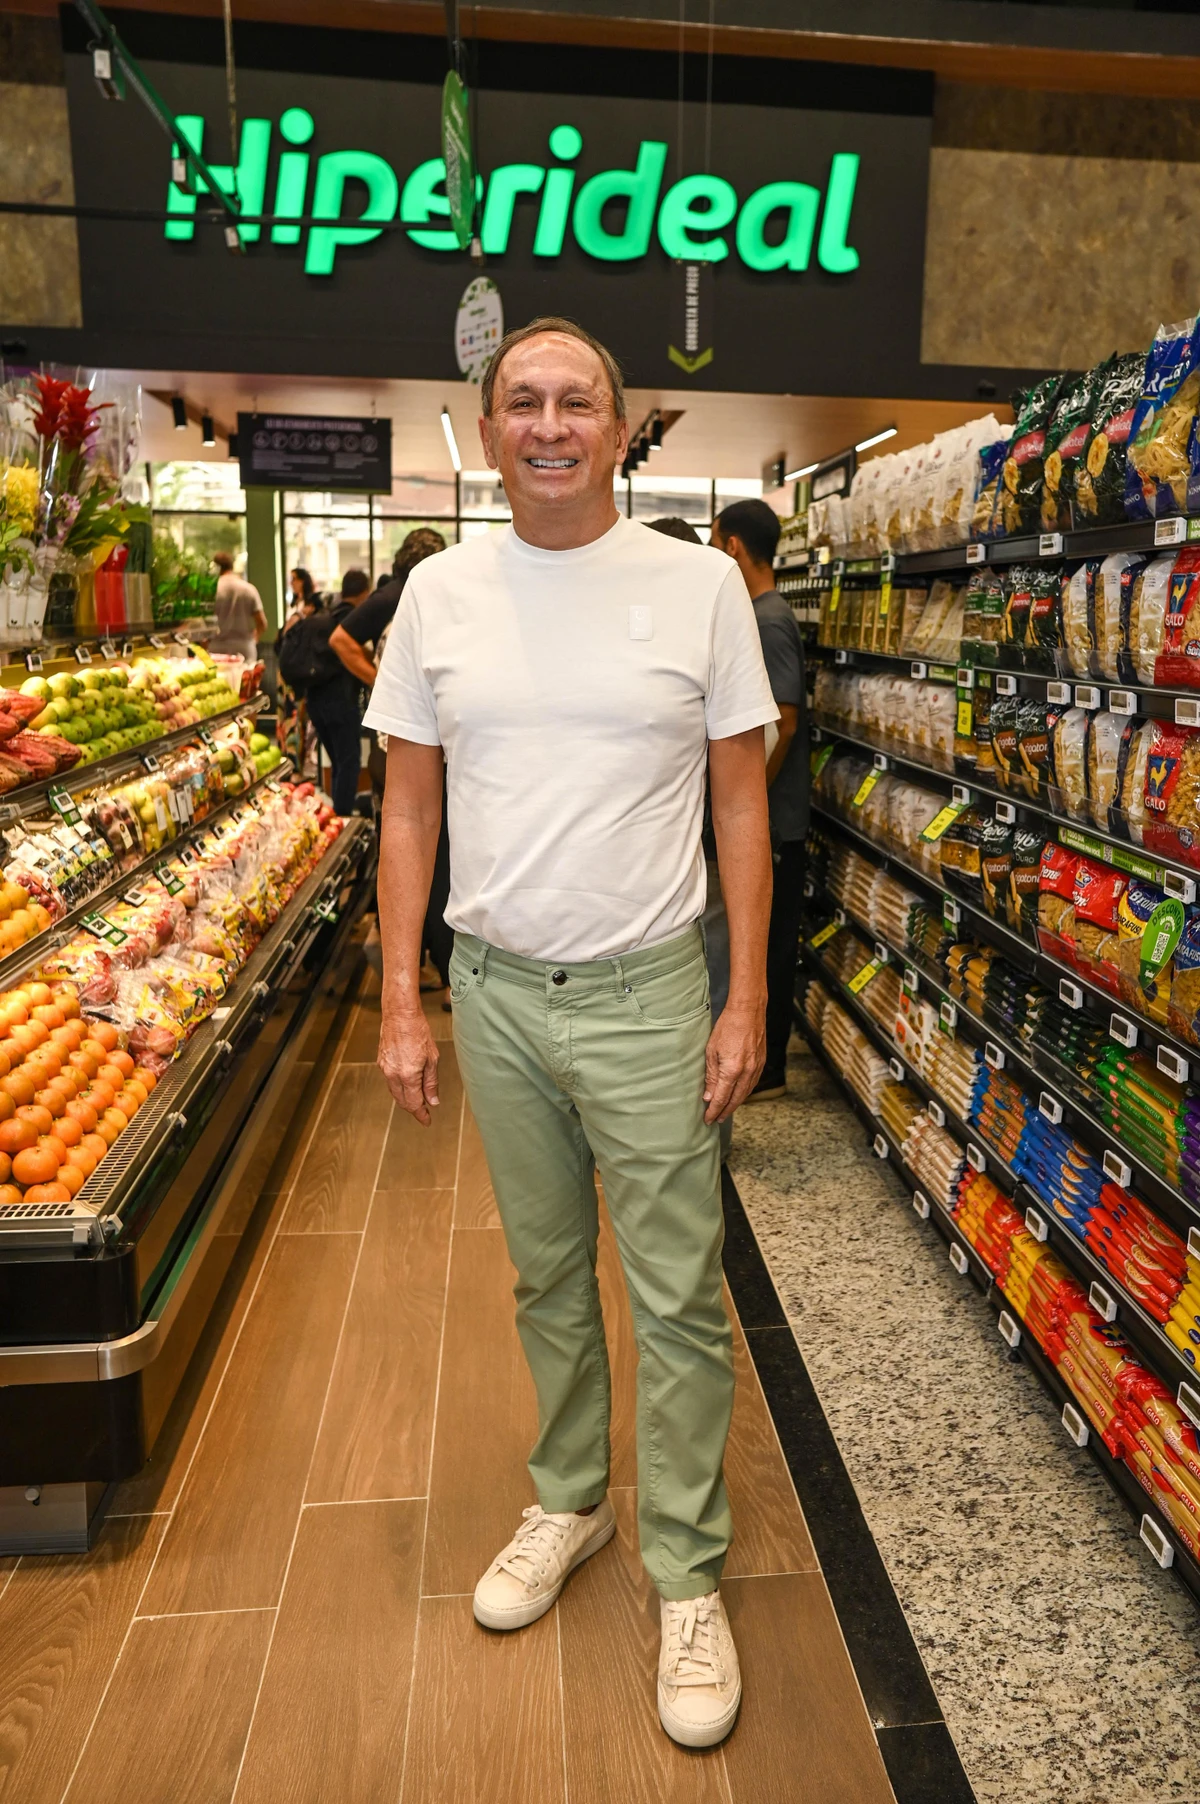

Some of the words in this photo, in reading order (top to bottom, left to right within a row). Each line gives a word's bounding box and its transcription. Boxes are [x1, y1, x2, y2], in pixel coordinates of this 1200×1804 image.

[164, 107, 860, 275] Hiperideal
[685, 265, 699, 294] PREÇO
[685, 295, 699, 306] DE
[685, 307, 699, 351] CONSULTA
[1144, 796, 1166, 811] GALO
[1069, 1330, 1080, 1346] GALO
[1063, 1357, 1075, 1372] GALO
[1101, 1372, 1113, 1388] GALO
[1094, 1400, 1106, 1418] GALO
[1146, 1407, 1160, 1425] GALO
[1140, 1439, 1153, 1457] GALO
[1181, 1493, 1195, 1513] GALO
